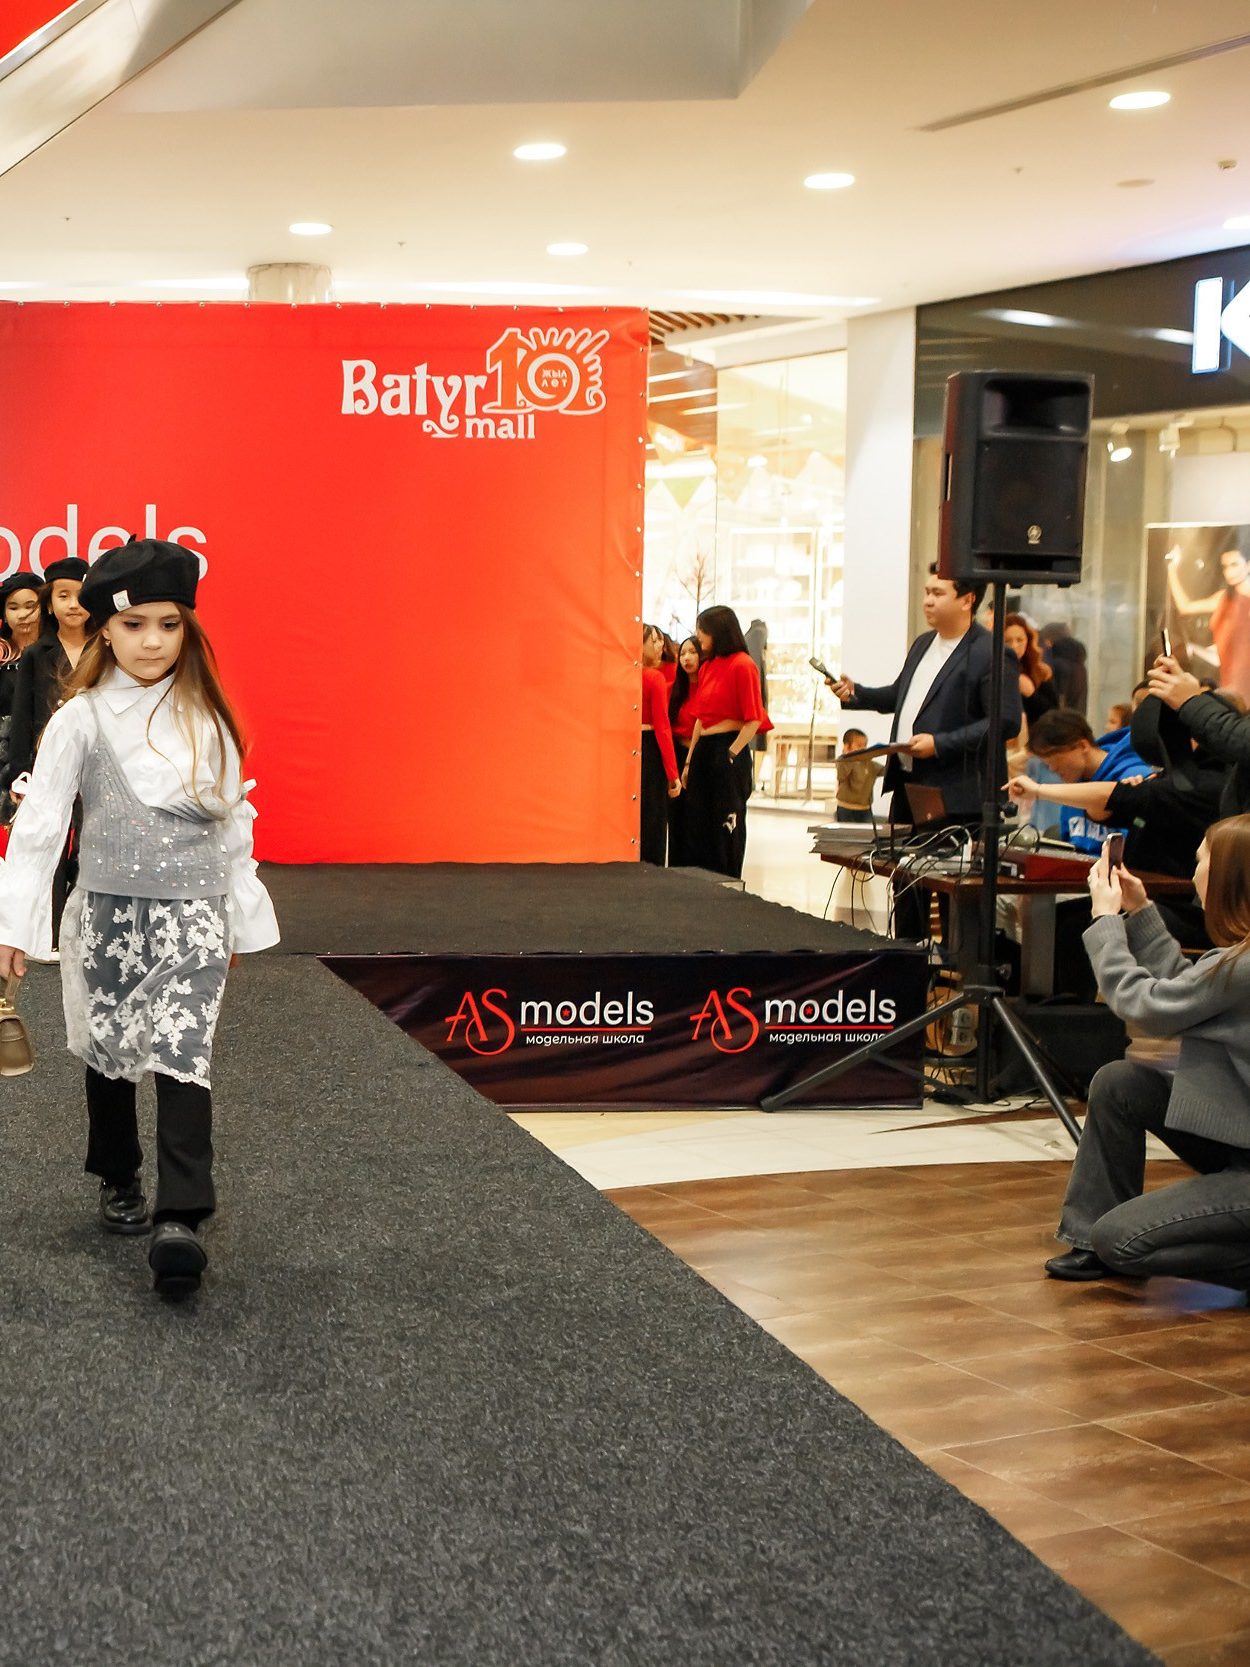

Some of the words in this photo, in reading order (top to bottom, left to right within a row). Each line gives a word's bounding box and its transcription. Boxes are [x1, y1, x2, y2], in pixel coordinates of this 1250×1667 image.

[341, 359, 488, 438] Batyr
[482, 327, 611, 416] 10
[465, 413, 536, 438] mall
[445, 988, 515, 1056] AS
[521, 991, 654, 1025] models
[525, 1035, 598, 1046] модельная
[602, 1034, 645, 1044] школа
[690, 987, 759, 1053] AS
[764, 989, 897, 1023] models
[769, 1032, 841, 1044] модельная
